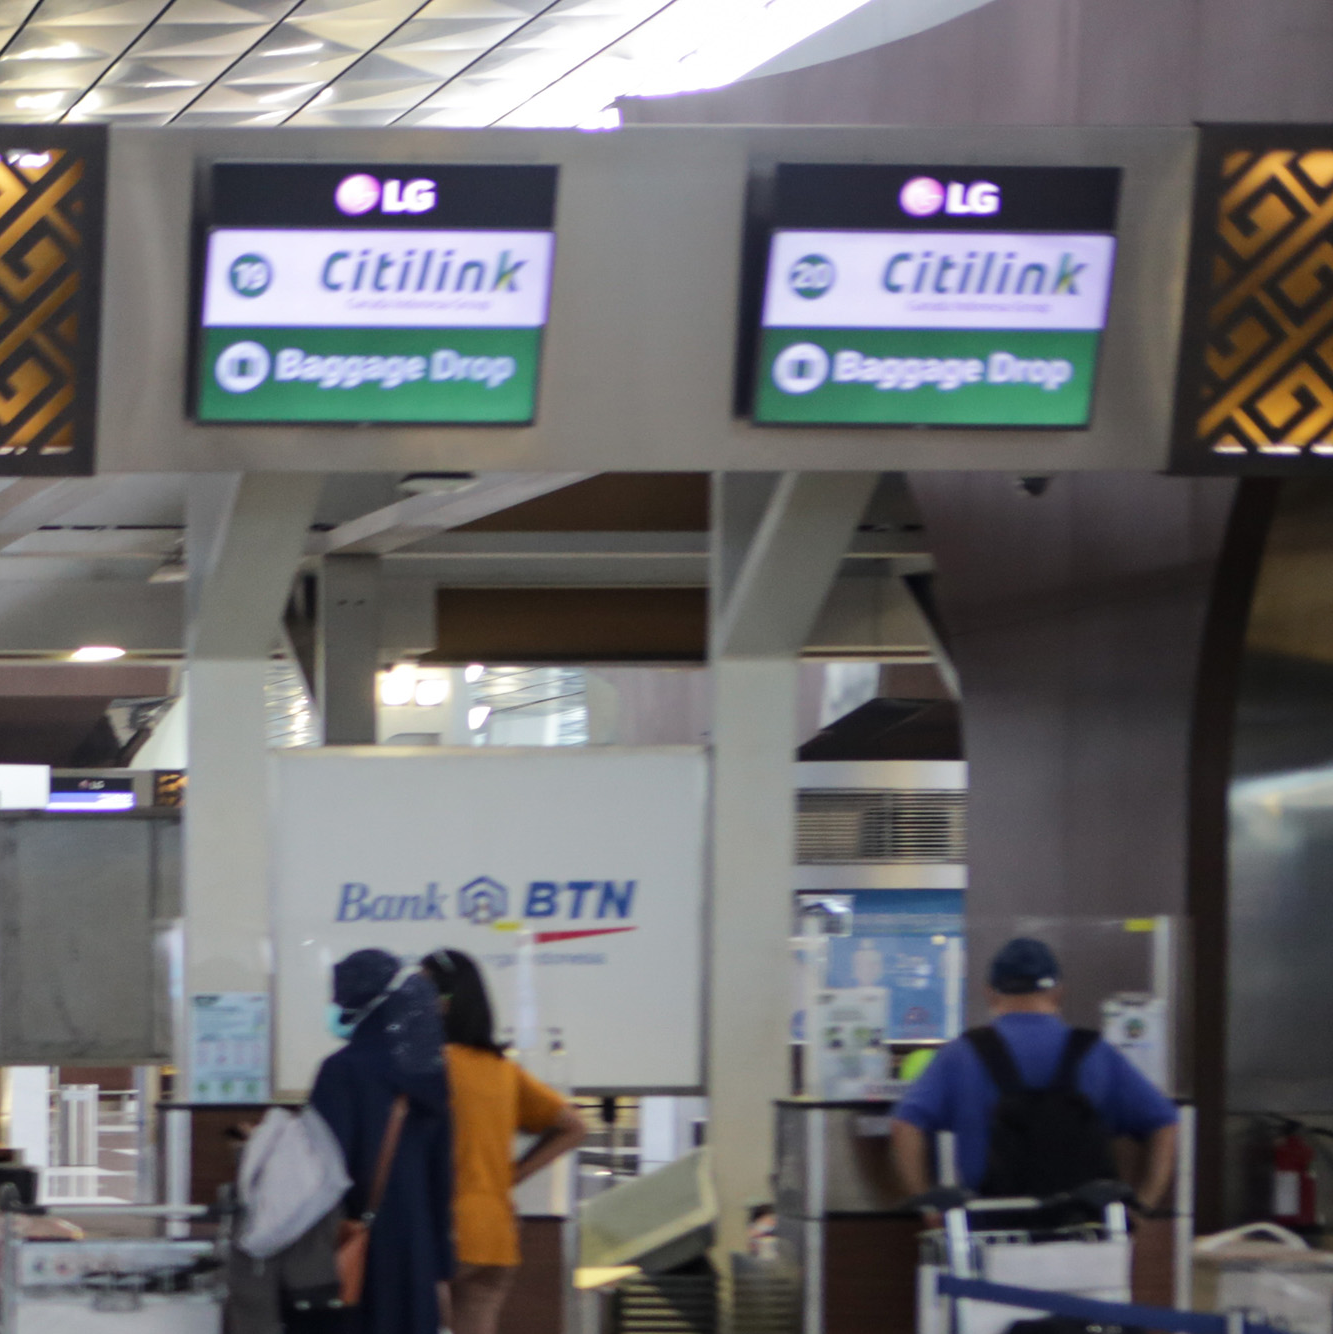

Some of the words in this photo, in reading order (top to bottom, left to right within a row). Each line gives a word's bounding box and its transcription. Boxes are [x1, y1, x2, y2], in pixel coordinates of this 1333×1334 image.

[382, 179, 437, 214] LG
[945, 181, 1001, 216] LG
[321, 250, 529, 293] Citilink
[882, 251, 1088, 295] Citilink
[274, 348, 426, 389] Baggage
[429, 349, 516, 389] Drop
[833, 350, 983, 391] Baggage
[987, 351, 1073, 391] Drop
[335, 882, 449, 922] Bank
[524, 880, 637, 919] BTN
